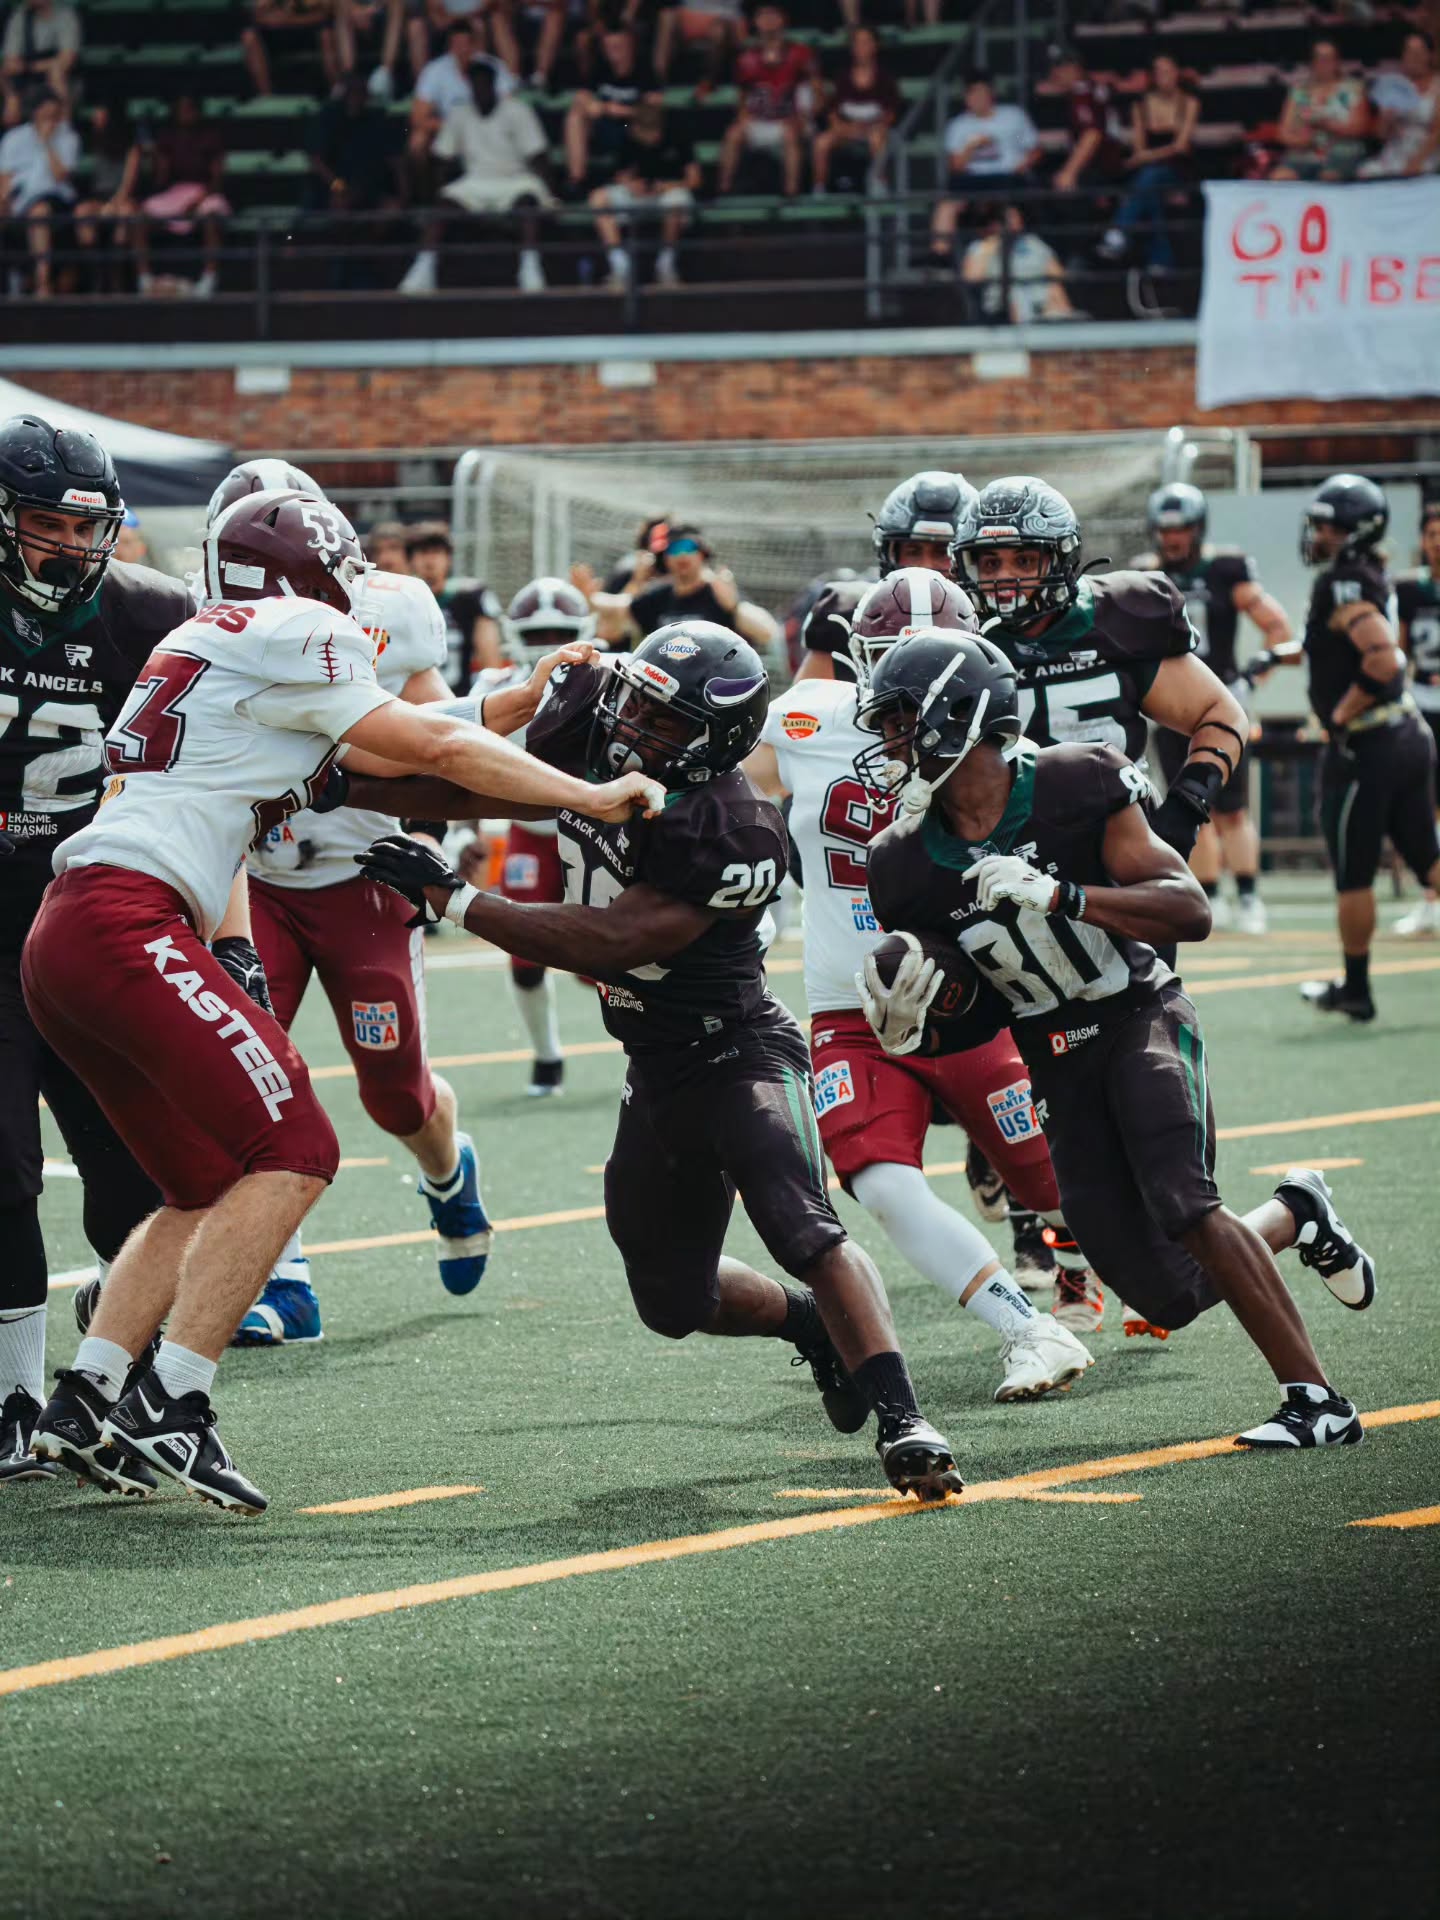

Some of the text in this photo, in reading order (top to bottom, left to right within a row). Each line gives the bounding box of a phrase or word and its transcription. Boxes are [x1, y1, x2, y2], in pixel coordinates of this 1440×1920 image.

[1232, 203, 1328, 261] GO
[1238, 257, 1440, 319] TRIBE
[301, 507, 341, 551] 53
[192, 603, 256, 633] ES
[660, 643, 698, 655] Sunkist
[23, 671, 103, 693] ANGELS
[643, 666, 670, 685] Riddell
[103, 648, 212, 774] 3
[7, 823, 58, 836] ERASMUS
[559, 809, 634, 877] BLACK ANGELS
[707, 858, 776, 908] 20
[957, 908, 1131, 1018] 80
[144, 935, 294, 1122] KASTEEL
[356, 1023, 398, 1044] USA
[815, 1081, 851, 1113] USA
[816, 1068, 849, 1091] ENTA'S
